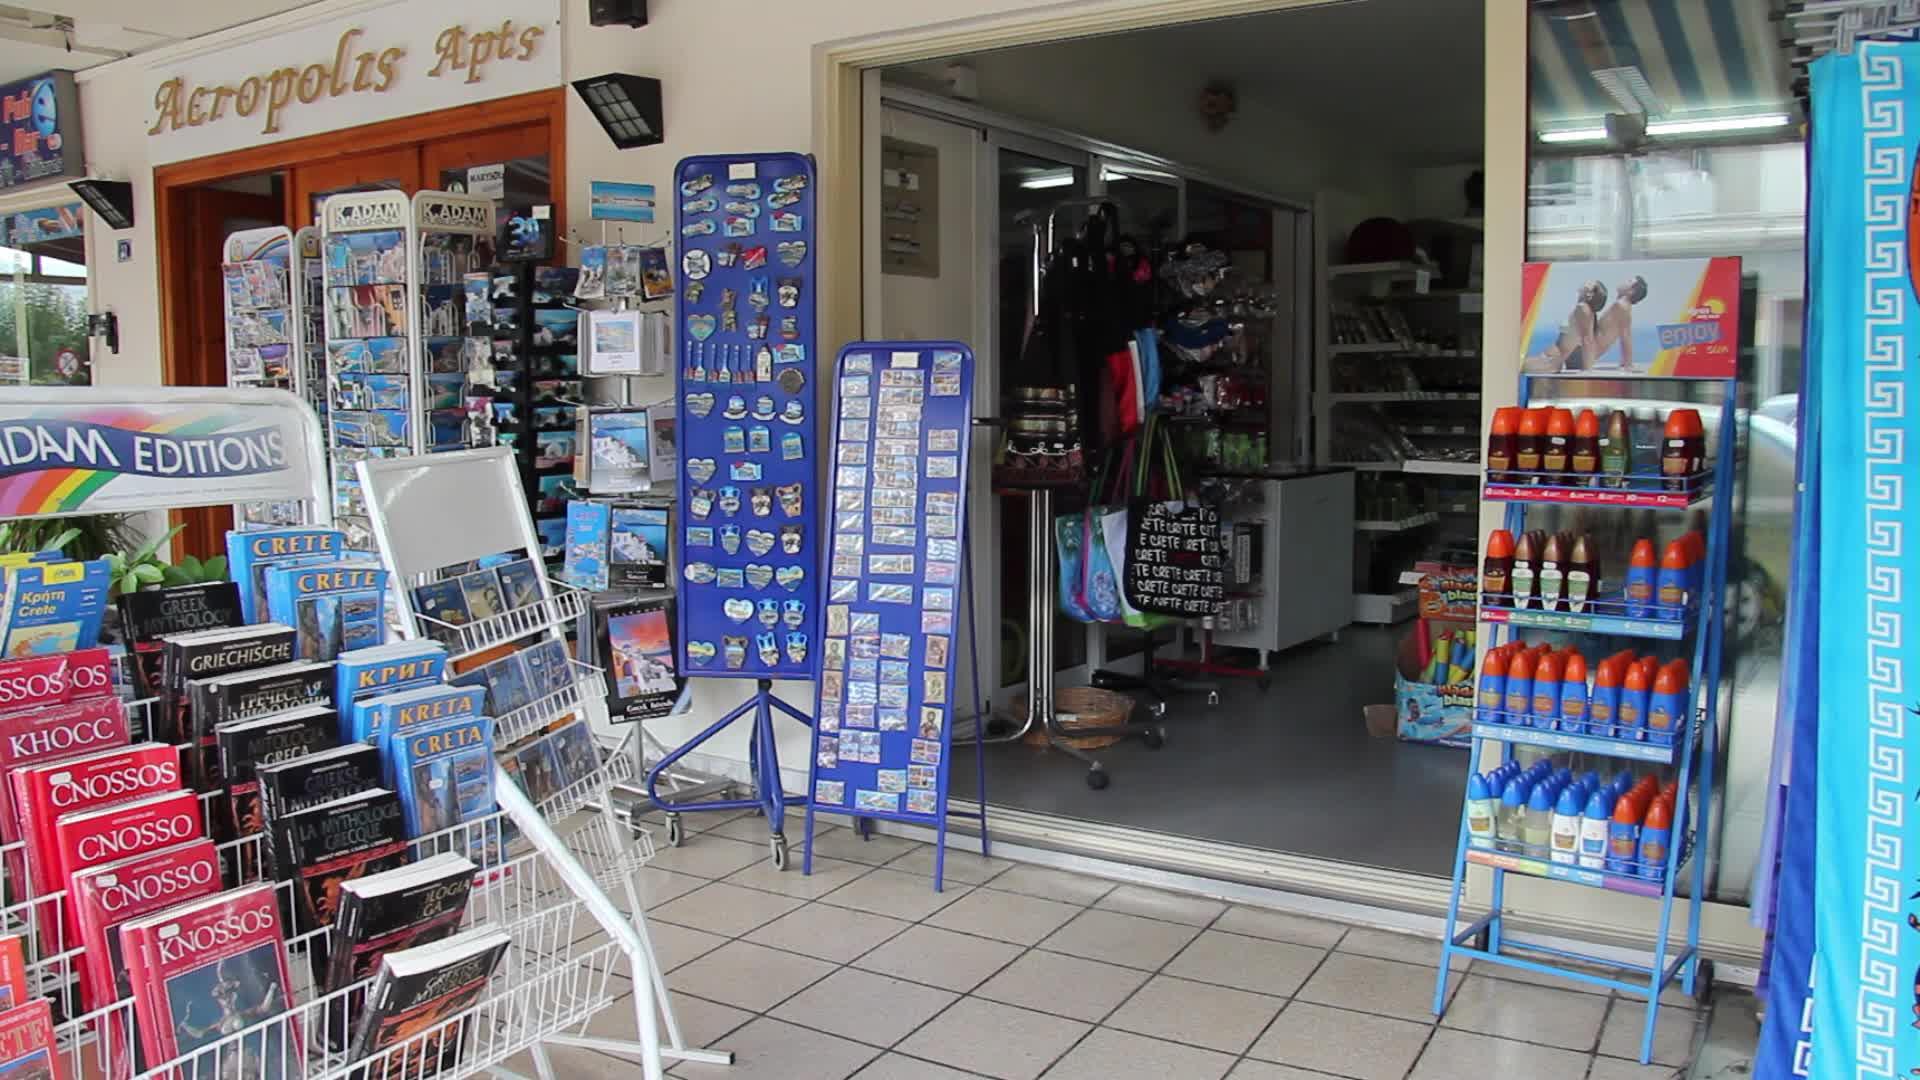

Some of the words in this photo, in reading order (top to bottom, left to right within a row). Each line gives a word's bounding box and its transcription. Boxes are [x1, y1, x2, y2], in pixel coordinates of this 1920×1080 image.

[147, 27, 406, 136] Acropolis
[428, 19, 544, 84] Apts
[1663, 321, 1719, 344] enjoy
[134, 429, 290, 477] EDITIONS
[252, 534, 333, 558] CRETE
[298, 570, 377, 594] CRETE
[18, 604, 57, 618] Crete
[160, 596, 208, 616] GREEK
[190, 642, 291, 672] GRIECHISCHE
[359, 660, 435, 688] КРИТ
[400, 696, 473, 726] KRETA
[413, 726, 482, 757] CRETA
[50, 760, 178, 808] CNOSSOS
[78, 813, 194, 862] CNOSSO
[102, 859, 214, 913] CNOSSO
[159, 904, 275, 965] KNOSSOS
